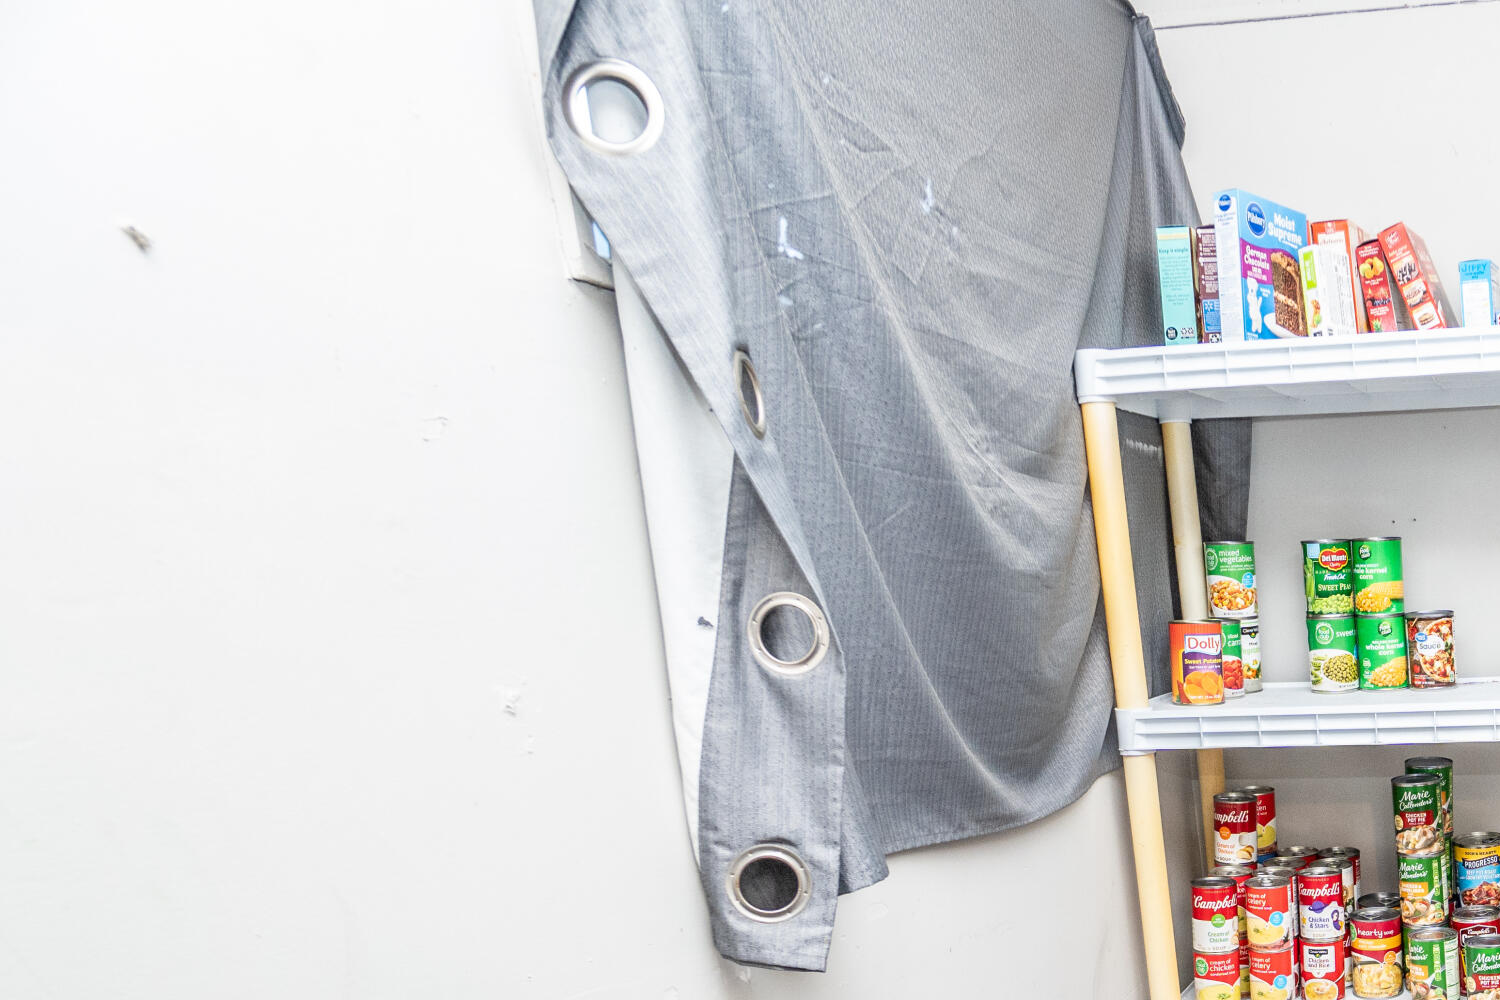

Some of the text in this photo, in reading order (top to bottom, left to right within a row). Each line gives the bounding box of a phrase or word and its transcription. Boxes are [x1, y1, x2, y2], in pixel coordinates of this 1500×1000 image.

[1273, 213, 1295, 232] Moist
[1268, 222, 1302, 246] Supreme
[1188, 637, 1220, 652] Dolly
[1400, 790, 1430, 802] Marie
[1214, 810, 1248, 824] mpbell's
[1400, 862, 1424, 871] Marie
[1465, 856, 1498, 868] PROGRESSO
[1299, 882, 1340, 899] Campbell's
[1248, 898, 1266, 907] celery
[1358, 928, 1383, 938] hearty
[1410, 946, 1424, 954] arie
[1209, 964, 1235, 972] chicken
[1251, 961, 1270, 970] celery
